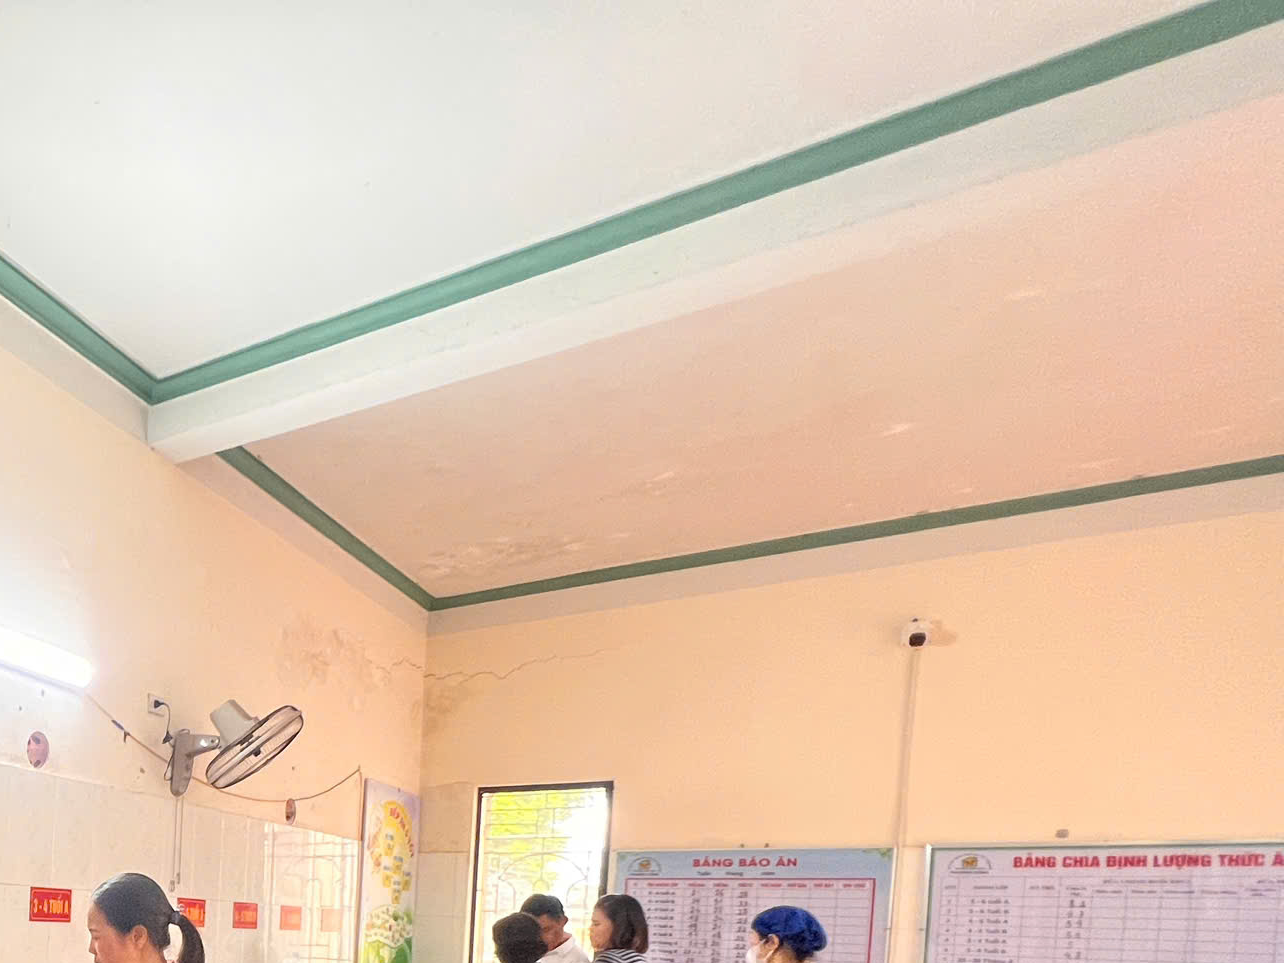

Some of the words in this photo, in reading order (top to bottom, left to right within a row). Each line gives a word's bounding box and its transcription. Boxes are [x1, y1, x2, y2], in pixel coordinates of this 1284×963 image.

[692, 855, 733, 867] BẢNG
[738, 855, 771, 867] BÁO
[775, 855, 798, 867] ĂN
[1012, 852, 1056, 868] BẢNG
[1062, 855, 1100, 868] CHIA
[1106, 855, 1148, 869] ĐỊNH
[1153, 854, 1212, 870] LƯỢNG
